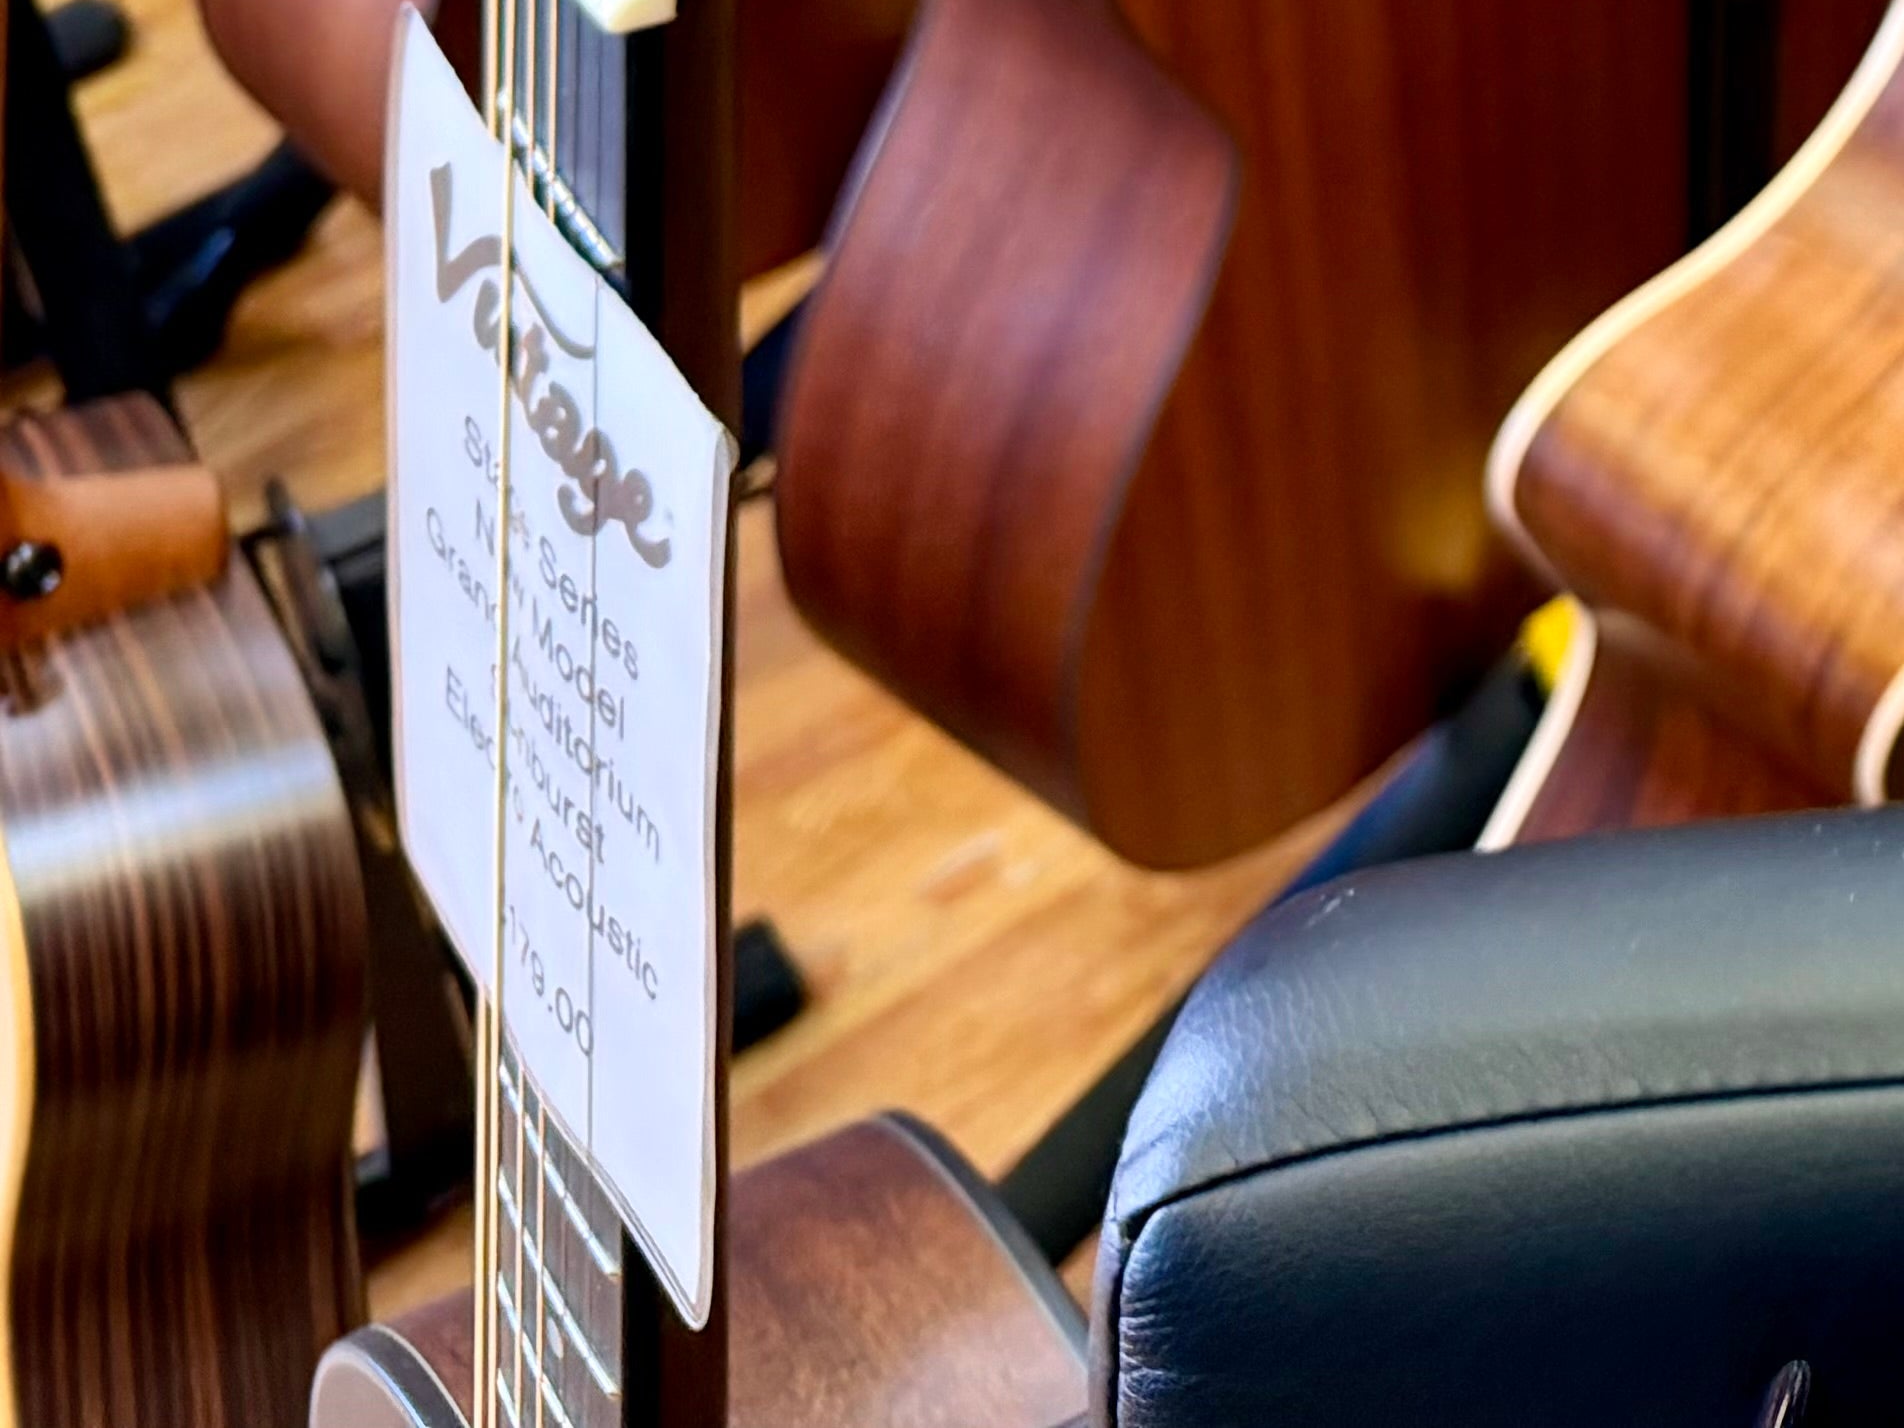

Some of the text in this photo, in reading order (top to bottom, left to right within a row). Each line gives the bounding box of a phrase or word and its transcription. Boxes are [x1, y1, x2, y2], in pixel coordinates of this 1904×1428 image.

[429, 161, 672, 569] Vintage
[533, 597, 625, 741] Model
[539, 535, 639, 680] Series
[500, 904, 594, 1057] 179.00
[531, 816, 658, 1001] Acoustic
